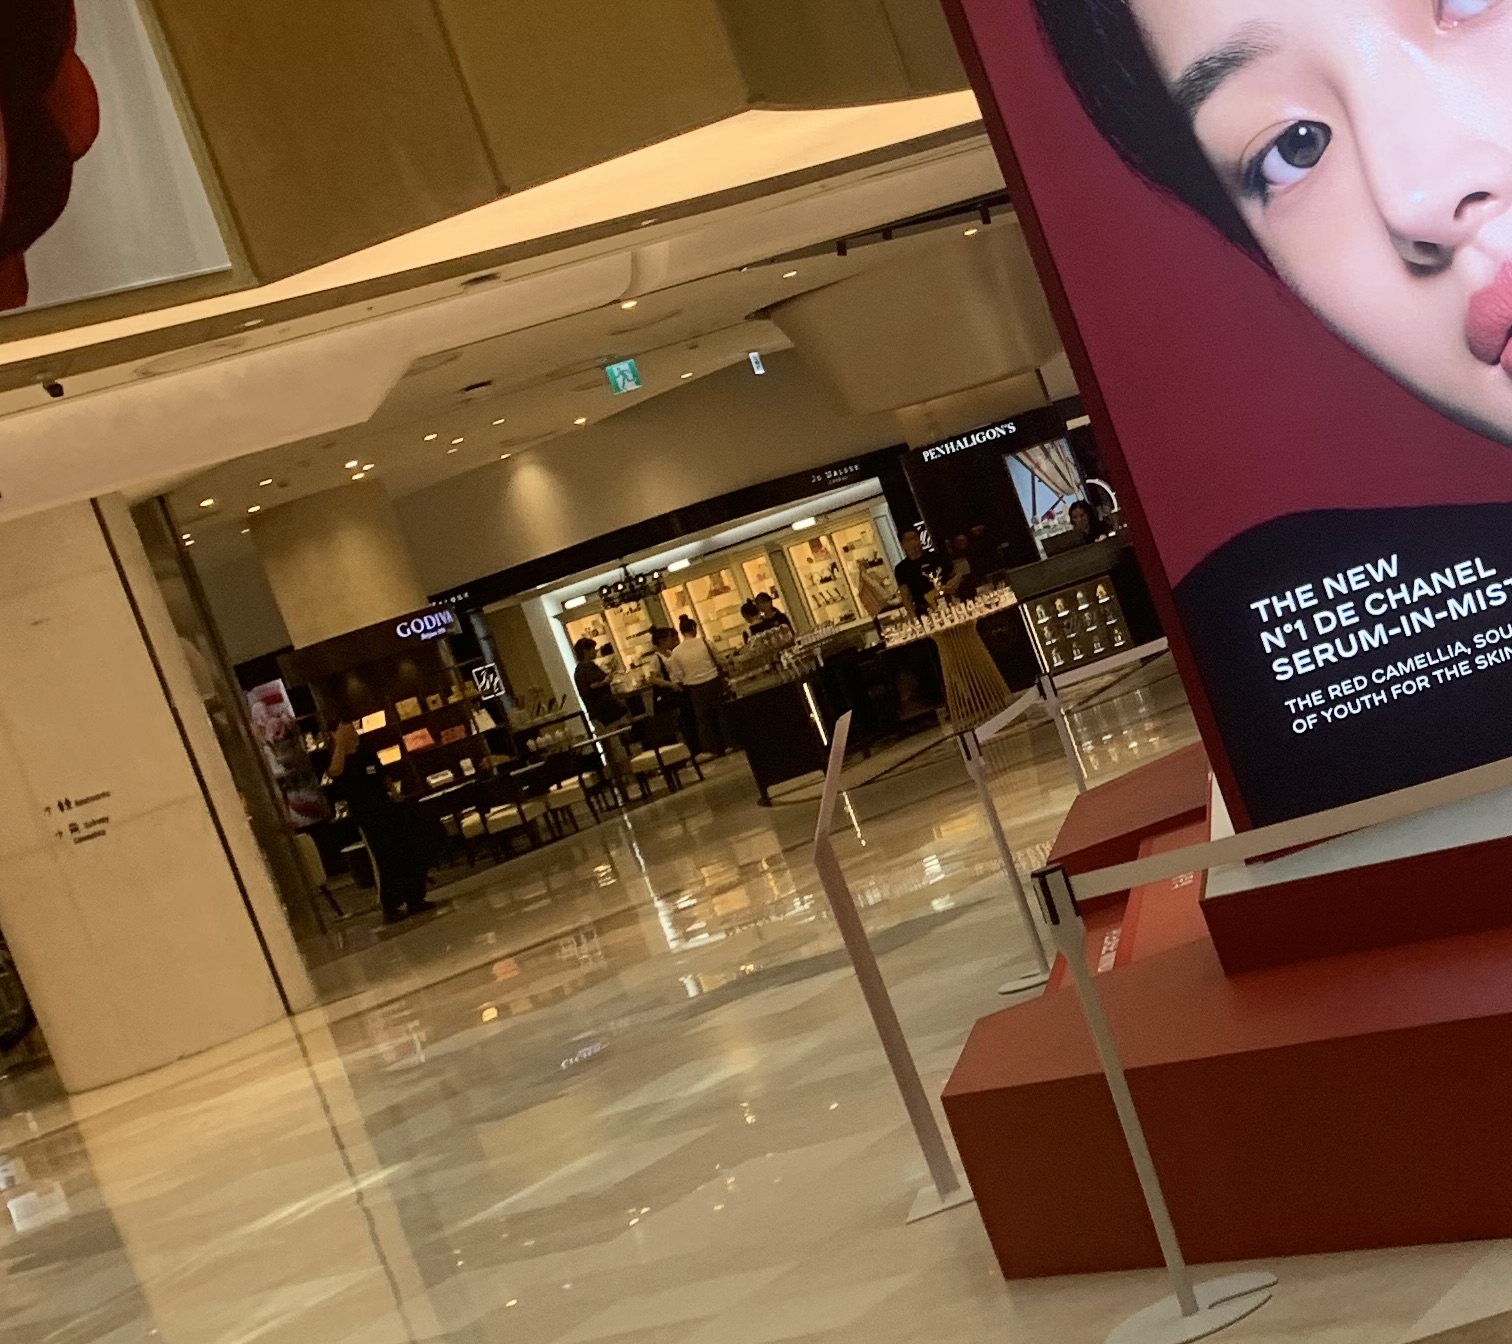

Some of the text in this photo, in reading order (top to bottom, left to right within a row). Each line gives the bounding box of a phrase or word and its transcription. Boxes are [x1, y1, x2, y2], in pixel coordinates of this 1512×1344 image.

[922, 422, 1017, 462] PENHALIGON'S
[1250, 554, 1399, 623] THE NEW
[1260, 557, 1497, 653] N°1 DE CHANEL
[1284, 689, 1325, 714] THE
[1328, 675, 1368, 700] RED
[1371, 642, 1472, 686] CAMELLIA,
[1291, 712, 1320, 734] OF
[1320, 690, 1388, 724] YOUTH
[1390, 675, 1431, 700] FOR
[1432, 661, 1473, 686] THE
